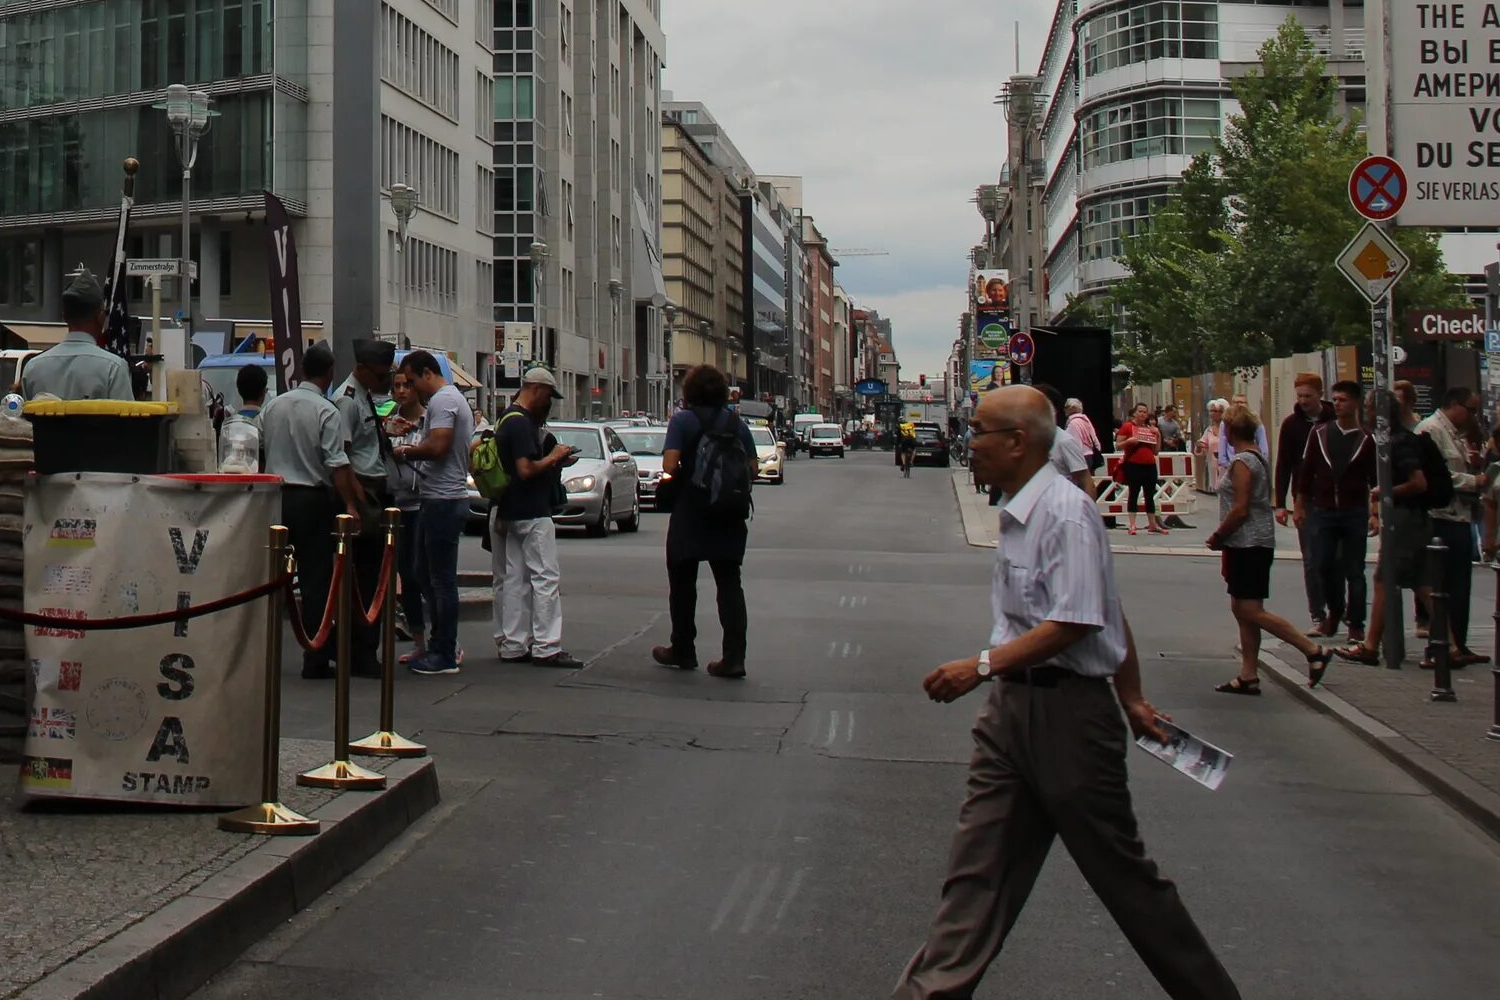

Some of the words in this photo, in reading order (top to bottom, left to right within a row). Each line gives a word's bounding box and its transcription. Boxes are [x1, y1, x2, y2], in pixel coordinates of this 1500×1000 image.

[1416, 4, 1464, 28] THE
[1420, 39, 1467, 63] ВЫ
[1416, 143, 1452, 168] DU
[130, 263, 174, 272] Zimmerstraße
[146, 527, 209, 764] VISA
[122, 771, 211, 794] STAMP
